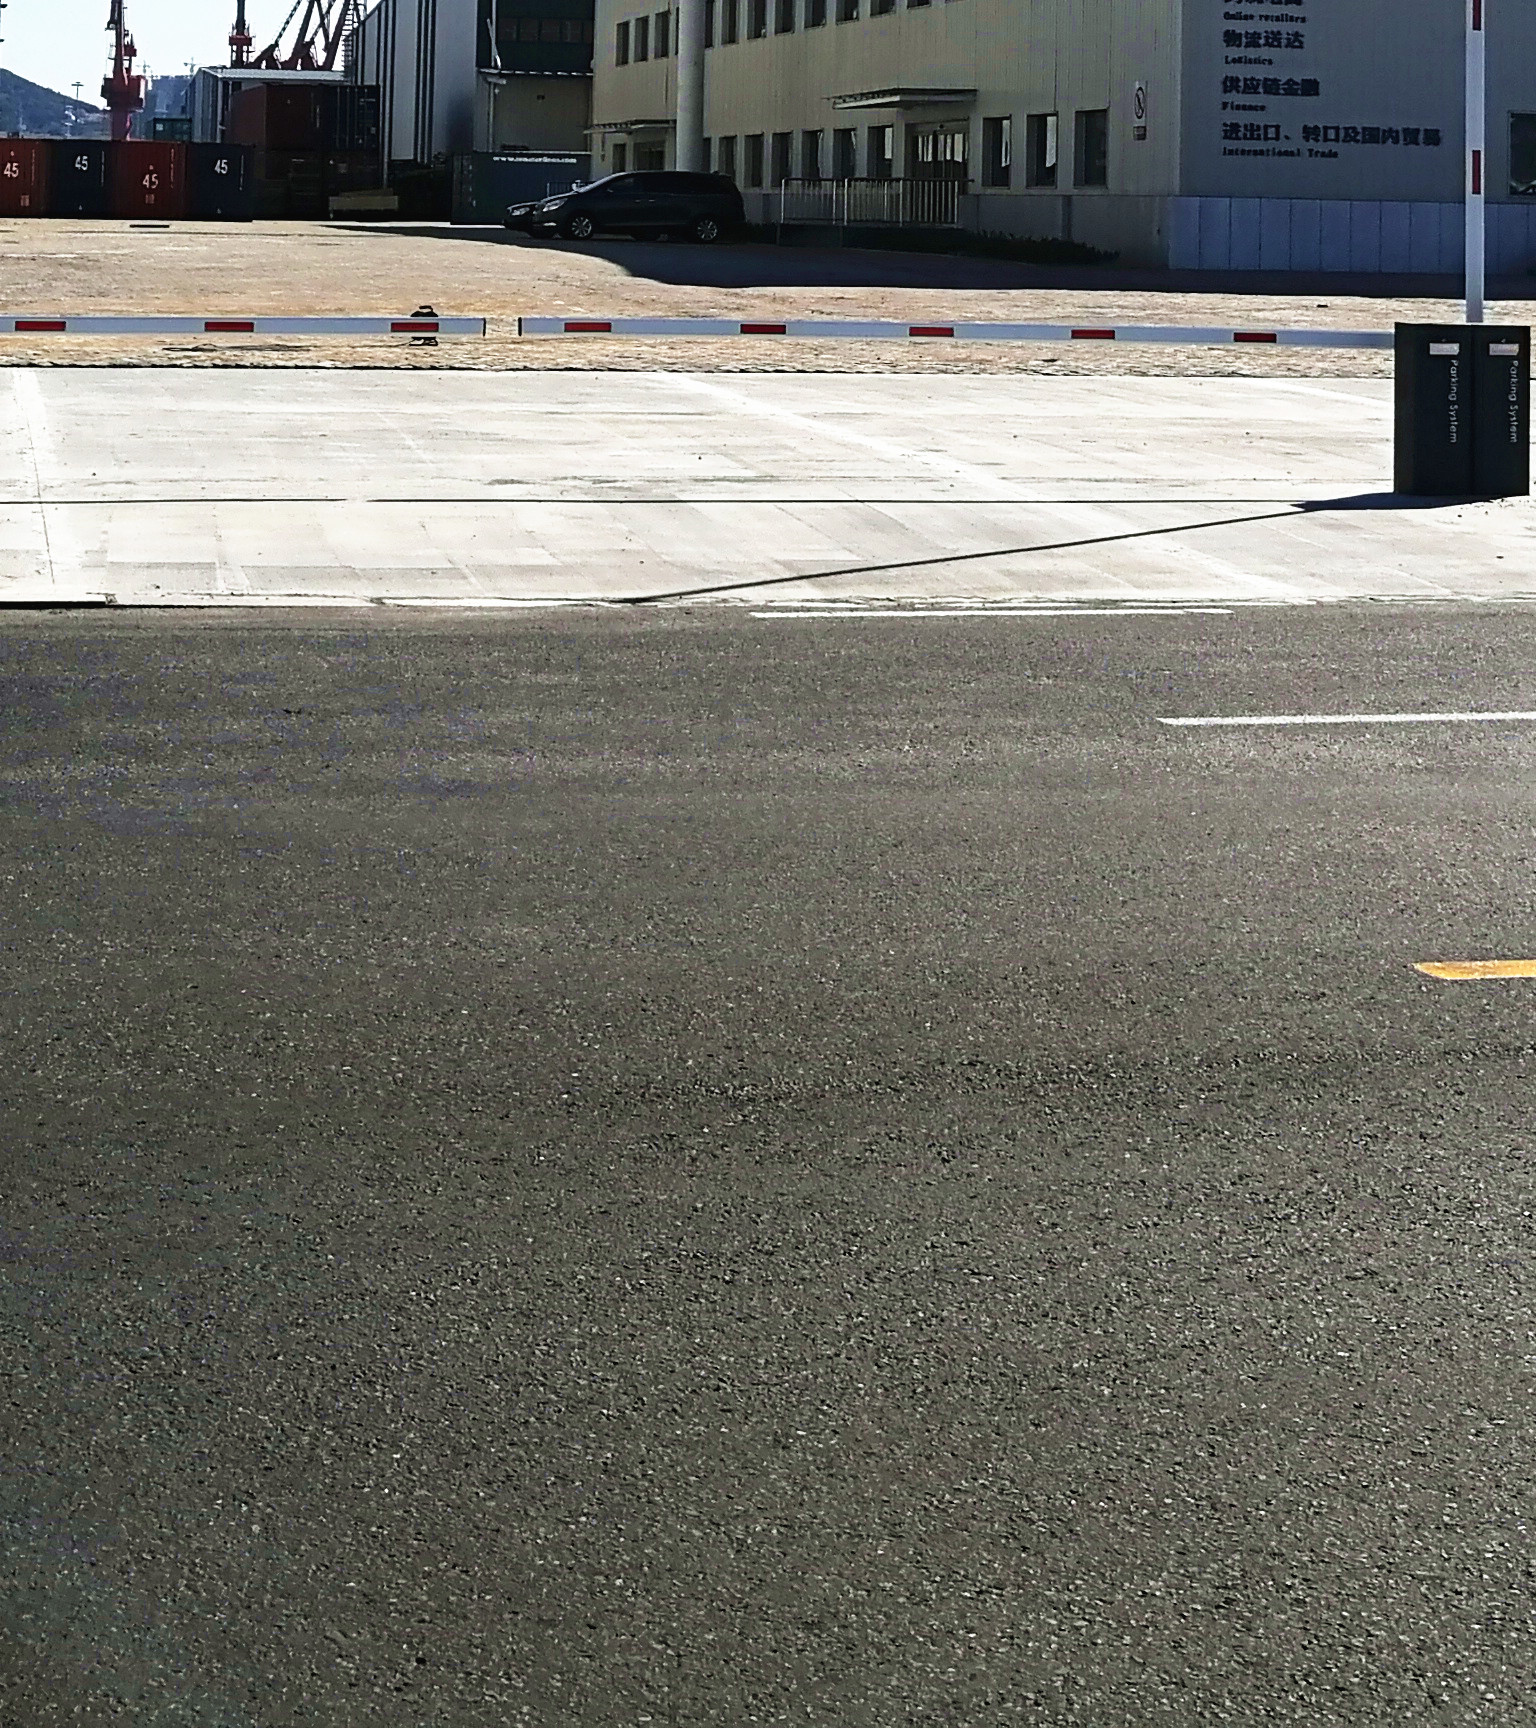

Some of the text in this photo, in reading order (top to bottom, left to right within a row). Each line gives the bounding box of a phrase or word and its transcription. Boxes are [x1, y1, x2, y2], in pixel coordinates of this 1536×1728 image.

[1224, 55, 1273, 66] Logistics
[1221, 101, 1267, 112] Finance
[1223, 147, 1339, 159] International Trade
[3, 162, 20, 178] 45
[75, 156, 89, 171] 45
[214, 160, 228, 175] 45
[142, 174, 159, 189] 45
[1447, 359, 1459, 443] Parking System
[1508, 360, 1519, 443] Parking System
